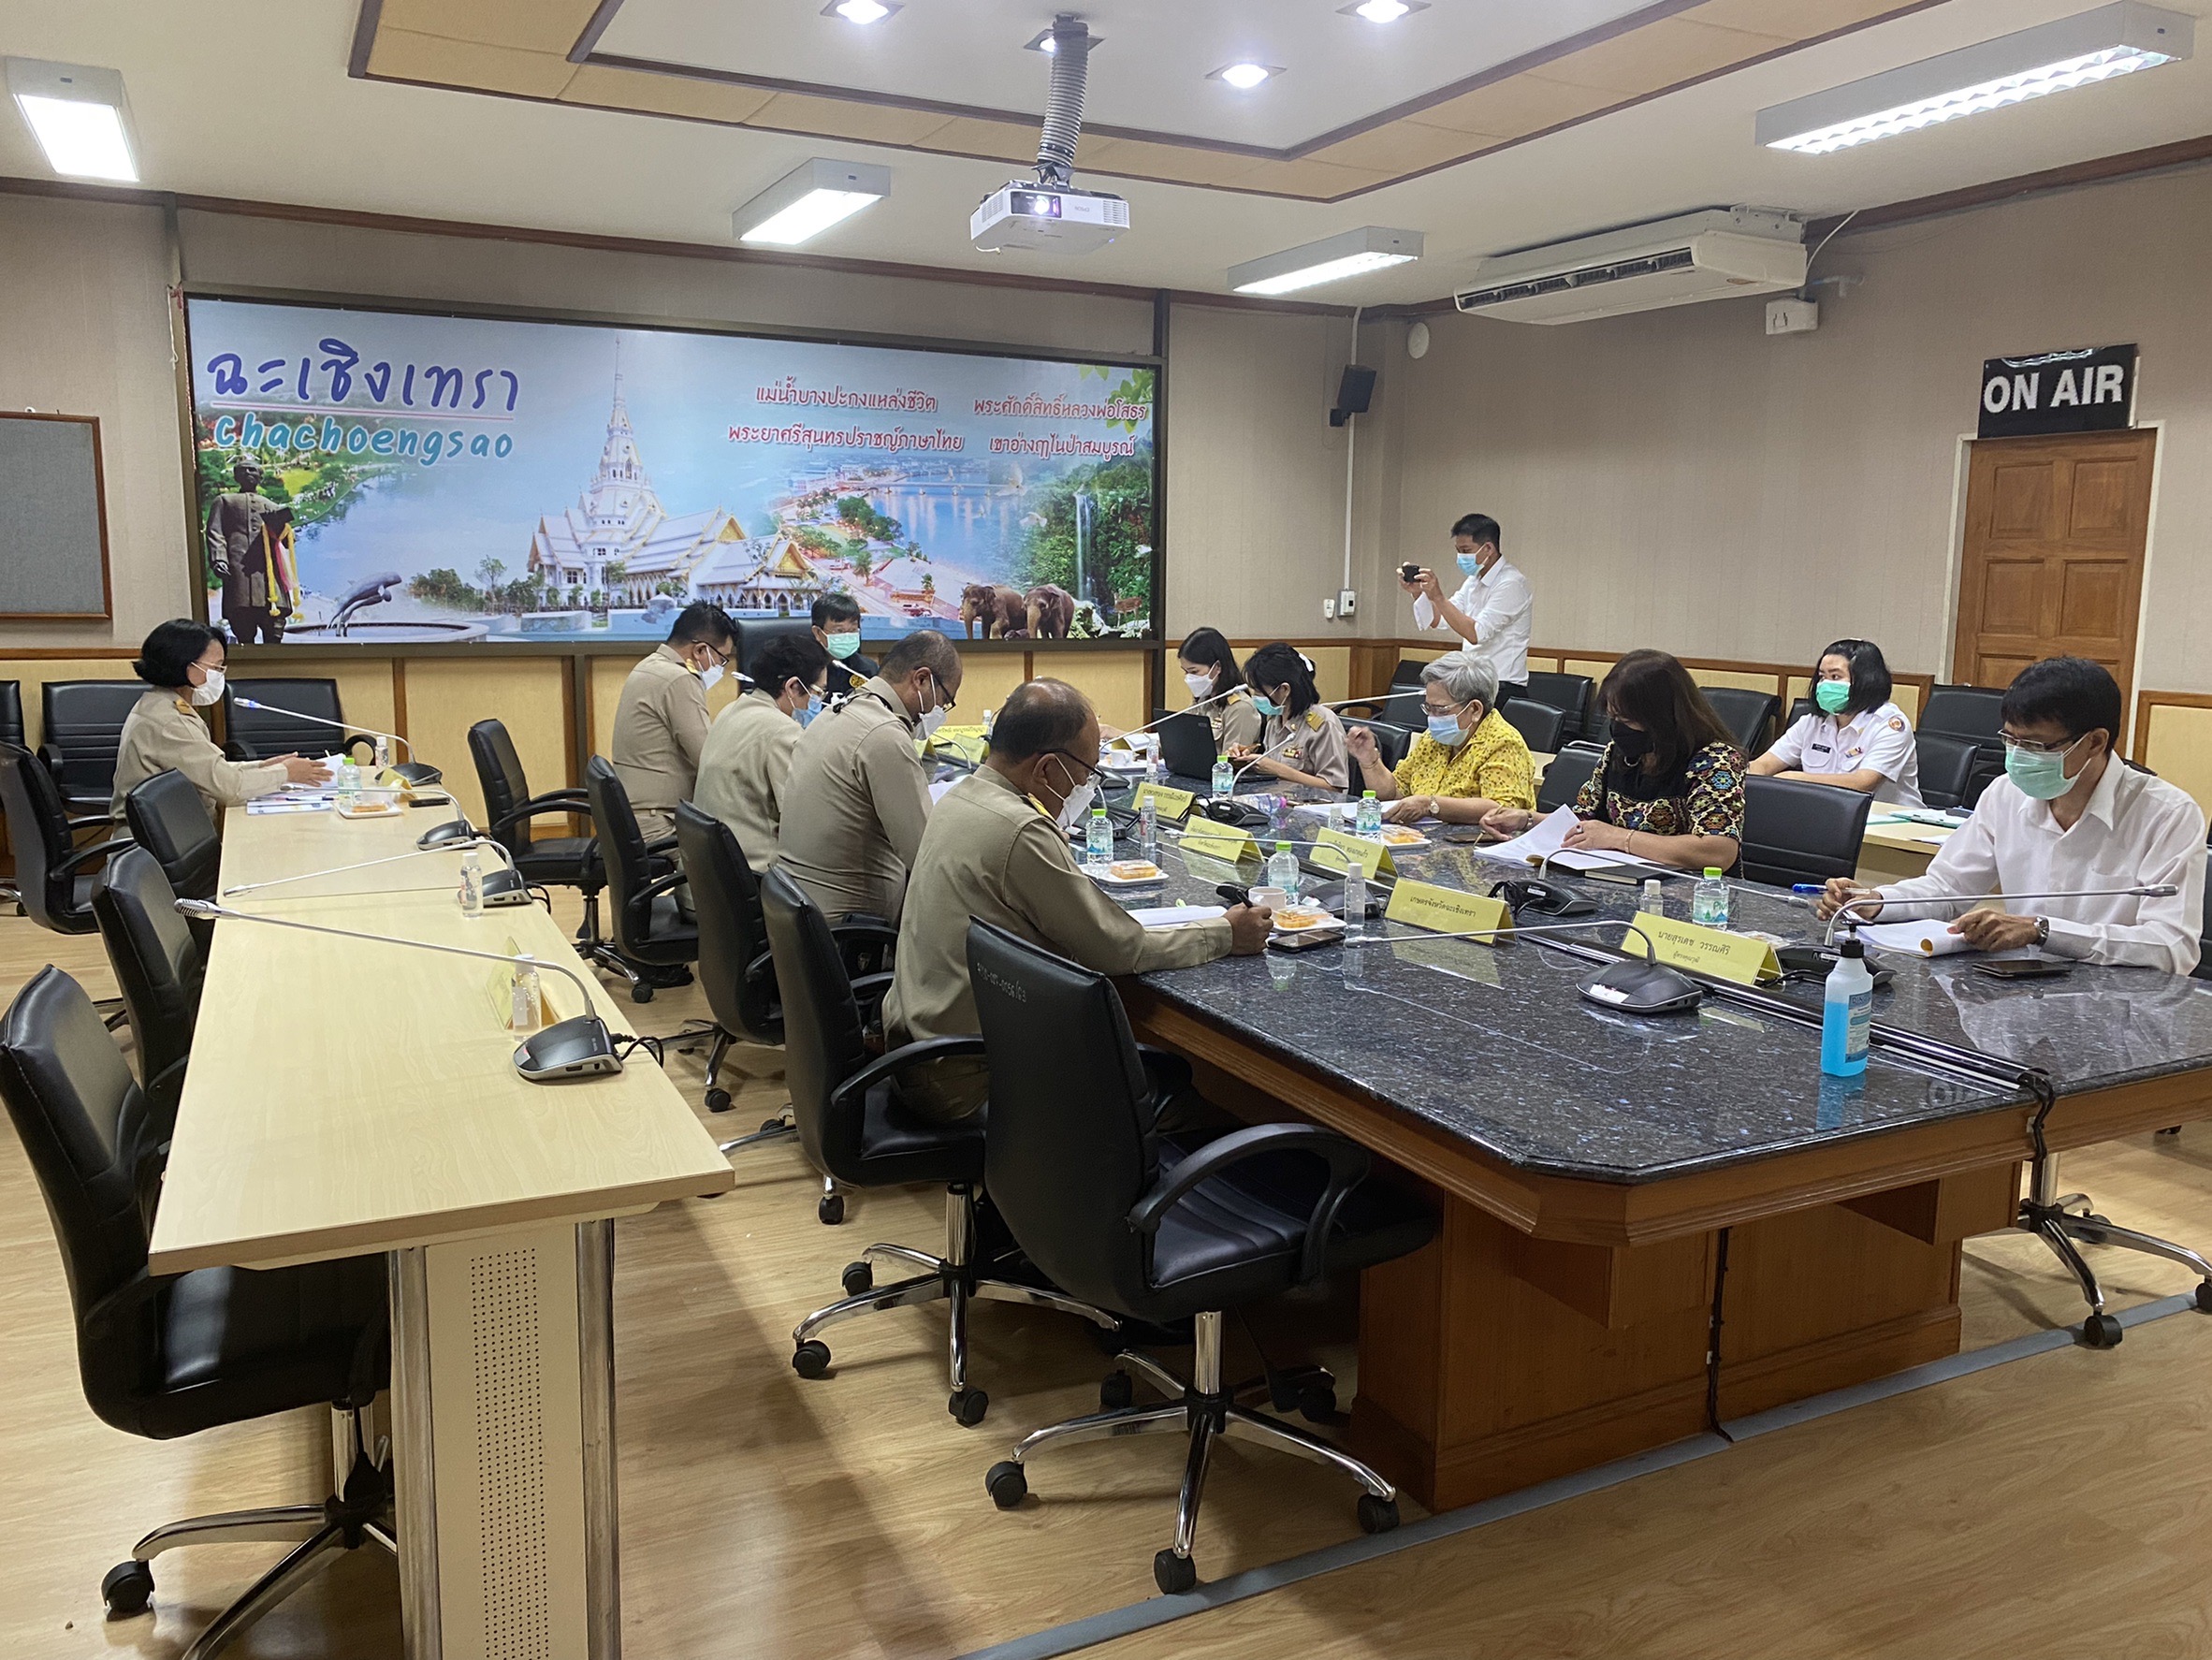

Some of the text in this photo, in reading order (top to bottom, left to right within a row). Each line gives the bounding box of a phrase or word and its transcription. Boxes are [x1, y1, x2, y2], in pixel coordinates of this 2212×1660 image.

[207, 338, 518, 411] ฉะเชิงเทรา
[1984, 364, 2124, 414] ON AIR
[756, 376, 937, 411] แม่น้ำบางปะกงแหล่งชีวิต
[974, 392, 1147, 419] พระศักดิ์สิทธิ์หลวงพ่อโสธร
[728, 423, 964, 453] พระยาศรีสุนทรปราชญ์ภาษาไทย
